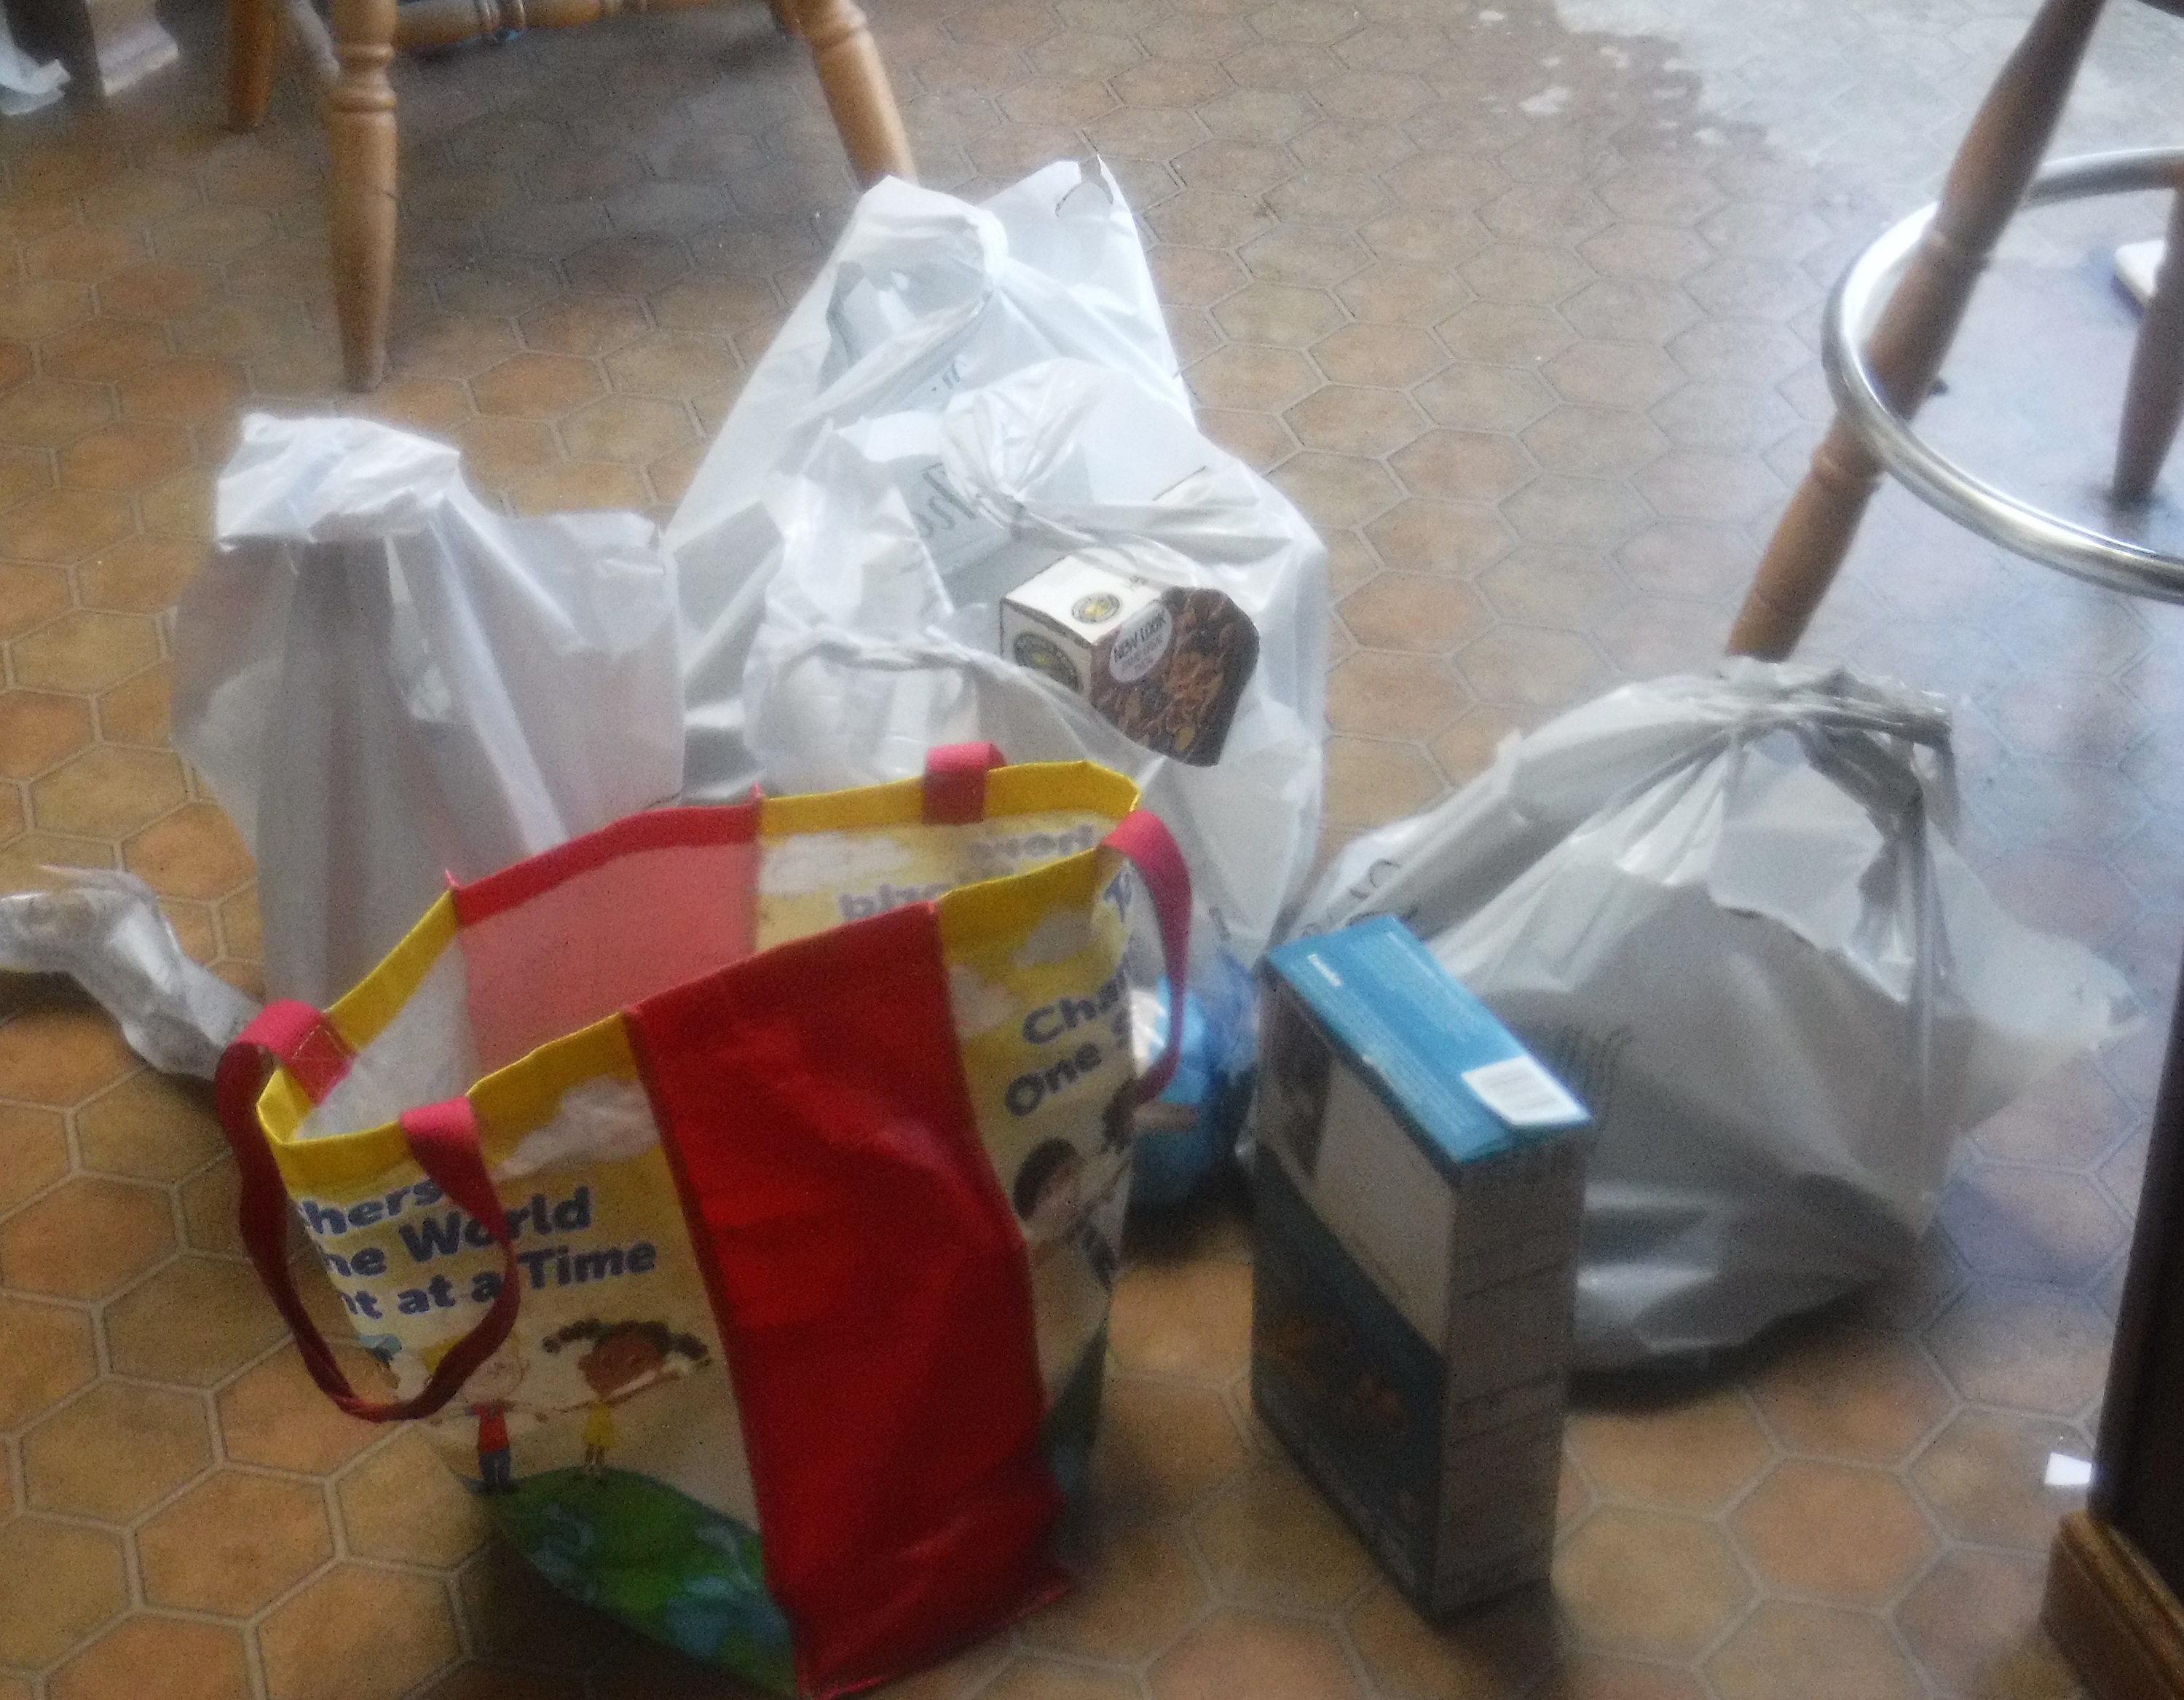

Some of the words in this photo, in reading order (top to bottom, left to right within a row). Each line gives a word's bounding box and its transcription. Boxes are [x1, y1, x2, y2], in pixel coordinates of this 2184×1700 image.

[1006, 1042, 1102, 1117] One
[398, 1186, 591, 1262] World
[398, 1275, 456, 1315] at
[471, 1271, 505, 1302] a
[517, 1242, 656, 1290] Time
